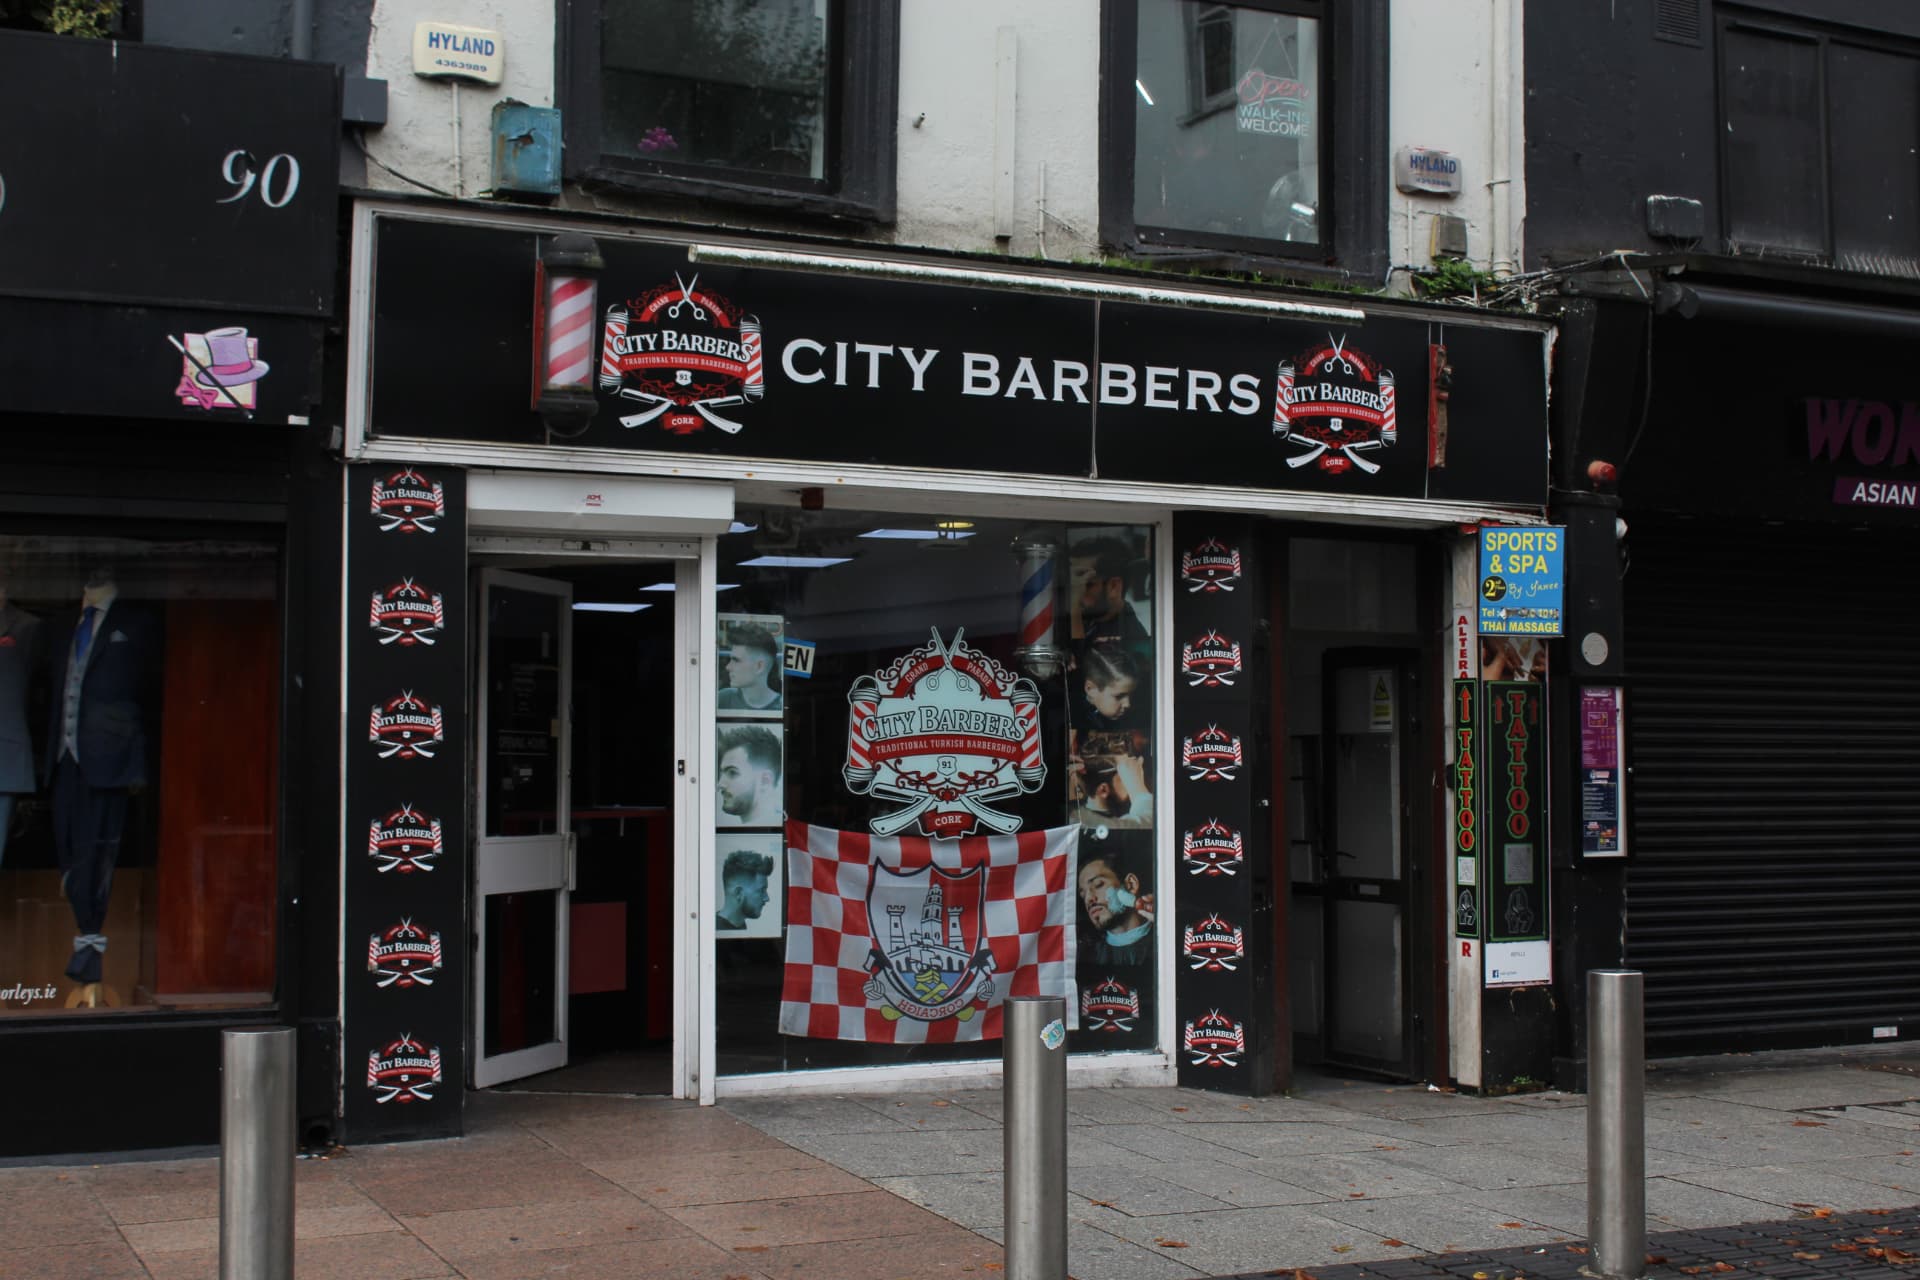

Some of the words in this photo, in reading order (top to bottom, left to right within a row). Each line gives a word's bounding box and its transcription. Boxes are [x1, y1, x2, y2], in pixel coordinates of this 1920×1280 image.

[427, 31, 496, 57] HYLAND
[1238, 71, 1311, 108] Open
[1239, 118, 1309, 137] WELCOME
[1410, 154, 1457, 174] HYLAND
[216, 149, 300, 208] 90
[611, 332, 658, 356] CITY
[781, 337, 941, 392] CITY
[960, 351, 1261, 416] BARBERS
[1283, 385, 1318, 405] CITY
[671, 417, 695, 426] CORK
[1851, 481, 1917, 506] ASIAN
[1485, 531, 1558, 552] SPORTS
[1489, 554, 1504, 574] &
[1508, 554, 1549, 575] SPA
[1508, 582, 1523, 600] By
[1481, 621, 1506, 633] THAI
[1508, 621, 1560, 633] MASSAGE
[904, 663, 929, 683] GRAND
[966, 662, 992, 687] PARADE
[860, 710, 916, 743] CITY
[918, 705, 1030, 743] BARBERS
[876, 739, 929, 755] TRADITIONAL
[930, 739, 965, 748] TURKISH
[966, 740, 1018, 754] BARBERSHOP
[941, 760, 952, 769] 91
[1505, 689, 1530, 839] TATTOO
[1457, 729, 1475, 851] TATTOO
[934, 815, 963, 827] CORK
[0, 983, 57, 1006] orleys.ie
